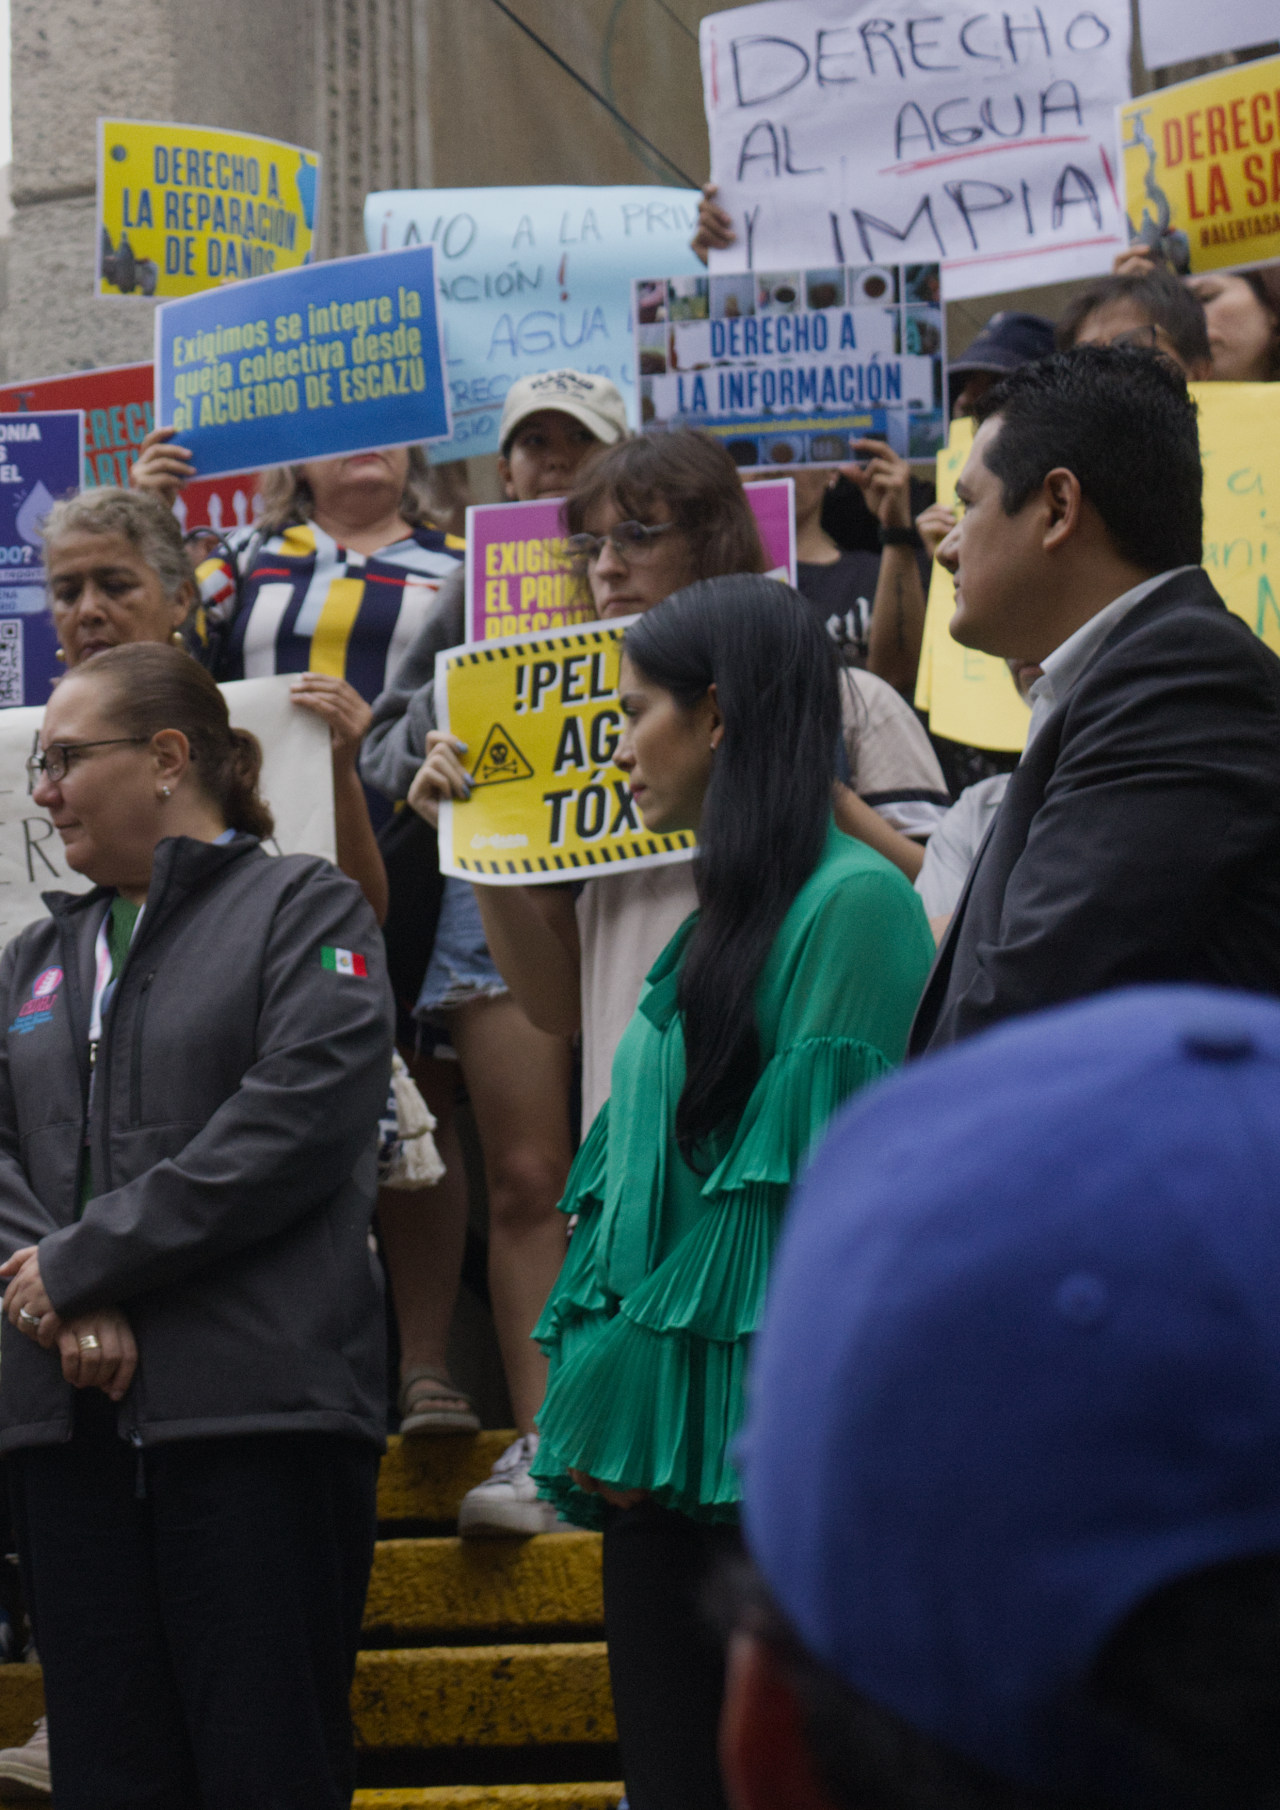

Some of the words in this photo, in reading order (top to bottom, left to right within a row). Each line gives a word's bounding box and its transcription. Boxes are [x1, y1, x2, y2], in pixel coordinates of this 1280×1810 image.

[737, 118, 825, 182] AL
[895, 80, 1083, 160] AGUA
[1163, 89, 1280, 168] DEREC
[153, 144, 261, 197] DERECHO
[266, 161, 280, 200] A
[1186, 163, 1232, 220] LA
[122, 186, 154, 229] LA
[164, 189, 297, 253] REPARACIÓN
[512, 213, 536, 250] A
[558, 207, 602, 245] LA
[164, 234, 197, 277] DE
[173, 319, 269, 368] Exigimos
[275, 312, 303, 344] se
[307, 294, 394, 339] integre
[397, 286, 422, 320] la
[486, 306, 609, 363] AGUA
[710, 314, 828, 358] DERECHO
[840, 312, 857, 350] A
[174, 360, 233, 401] queja
[238, 339, 346, 385] colectiva
[351, 323, 422, 365] desde
[676, 374, 708, 413] LA
[720, 353, 902, 410] INFORMACIÓN
[173, 399, 193, 432] el
[199, 378, 300, 428] ACUERDO
[304, 372, 335, 409] DE
[0, 464, 23, 483] EL
[485, 579, 513, 613] EL
